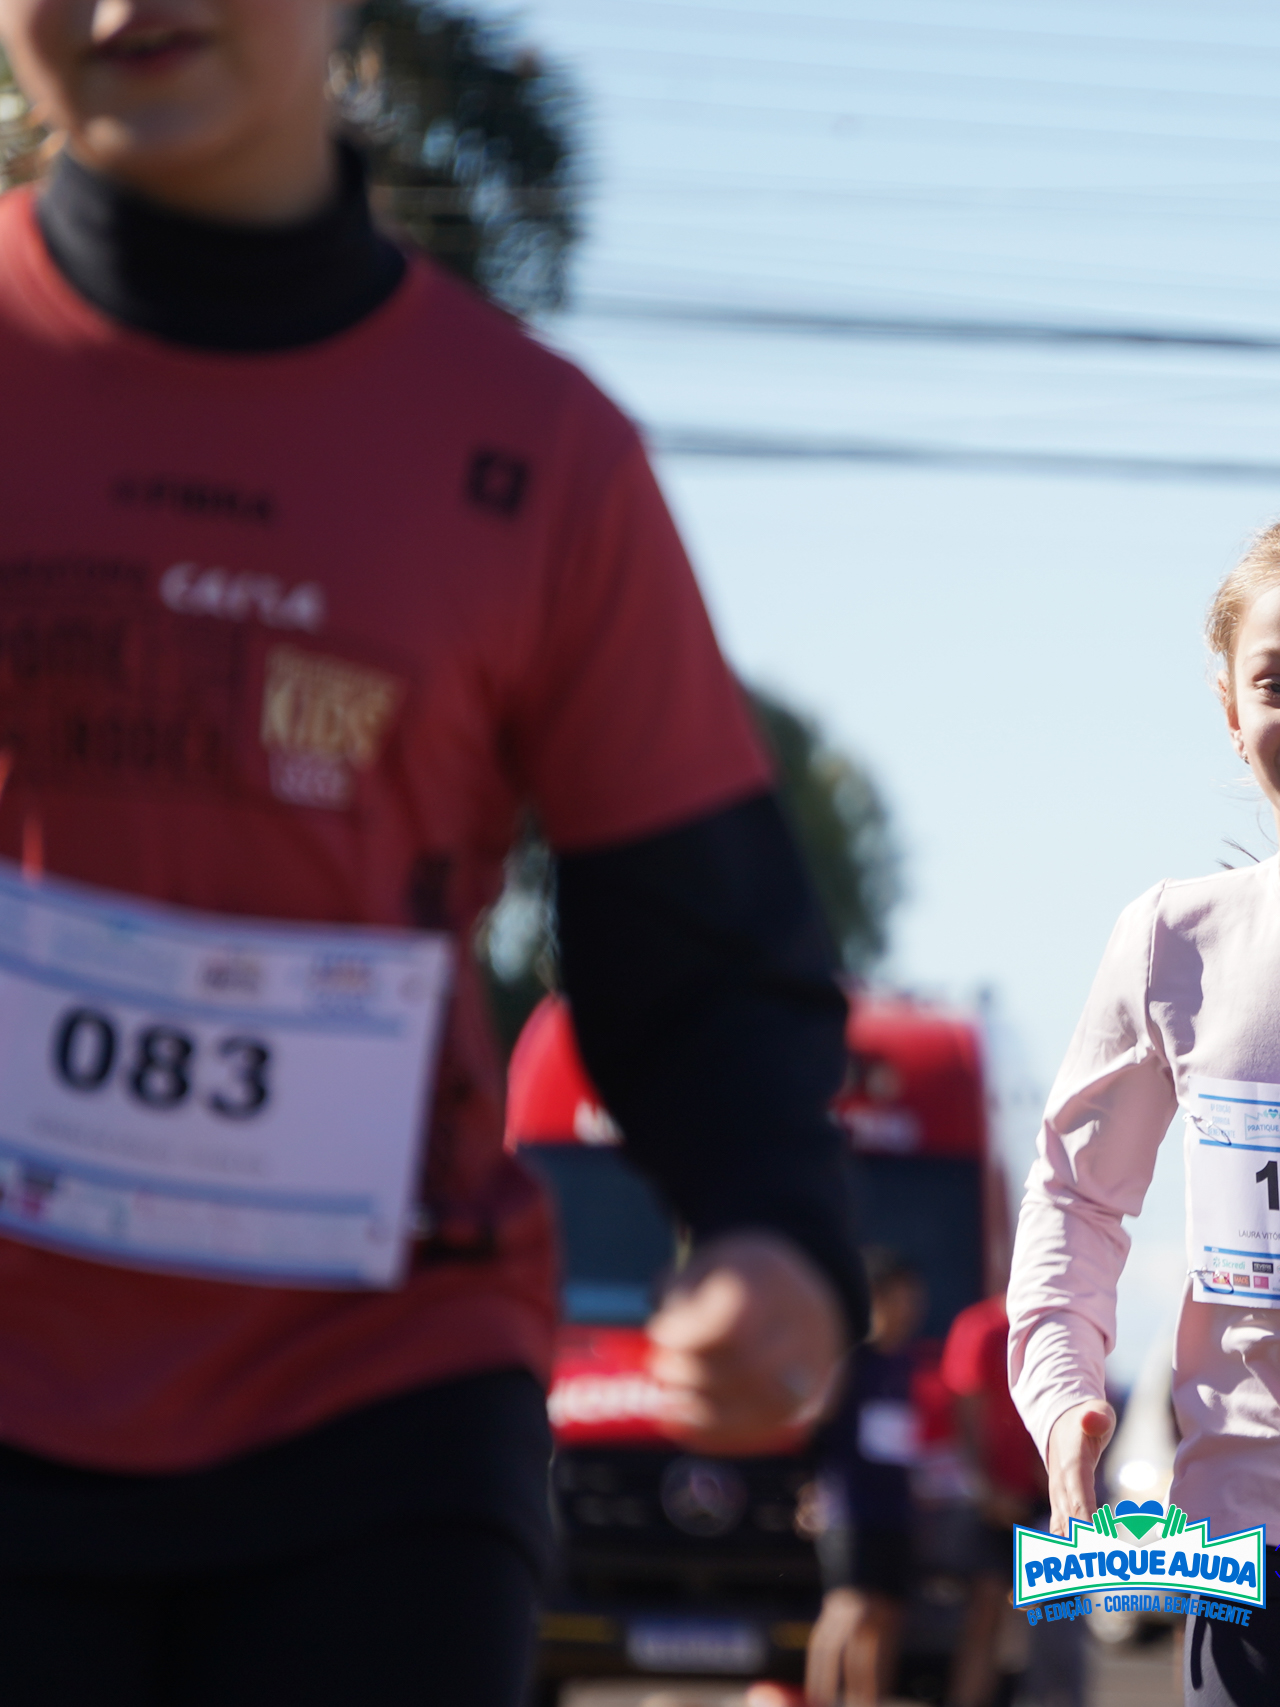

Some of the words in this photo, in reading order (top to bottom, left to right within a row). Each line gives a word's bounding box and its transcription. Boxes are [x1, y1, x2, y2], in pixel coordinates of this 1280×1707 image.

[51, 1003, 273, 1121] 083
[1247, 1124, 1279, 1132] PRATIQUE
[1238, 1229, 1261, 1239] LAURA
[1221, 1259, 1246, 1270] Sicredi
